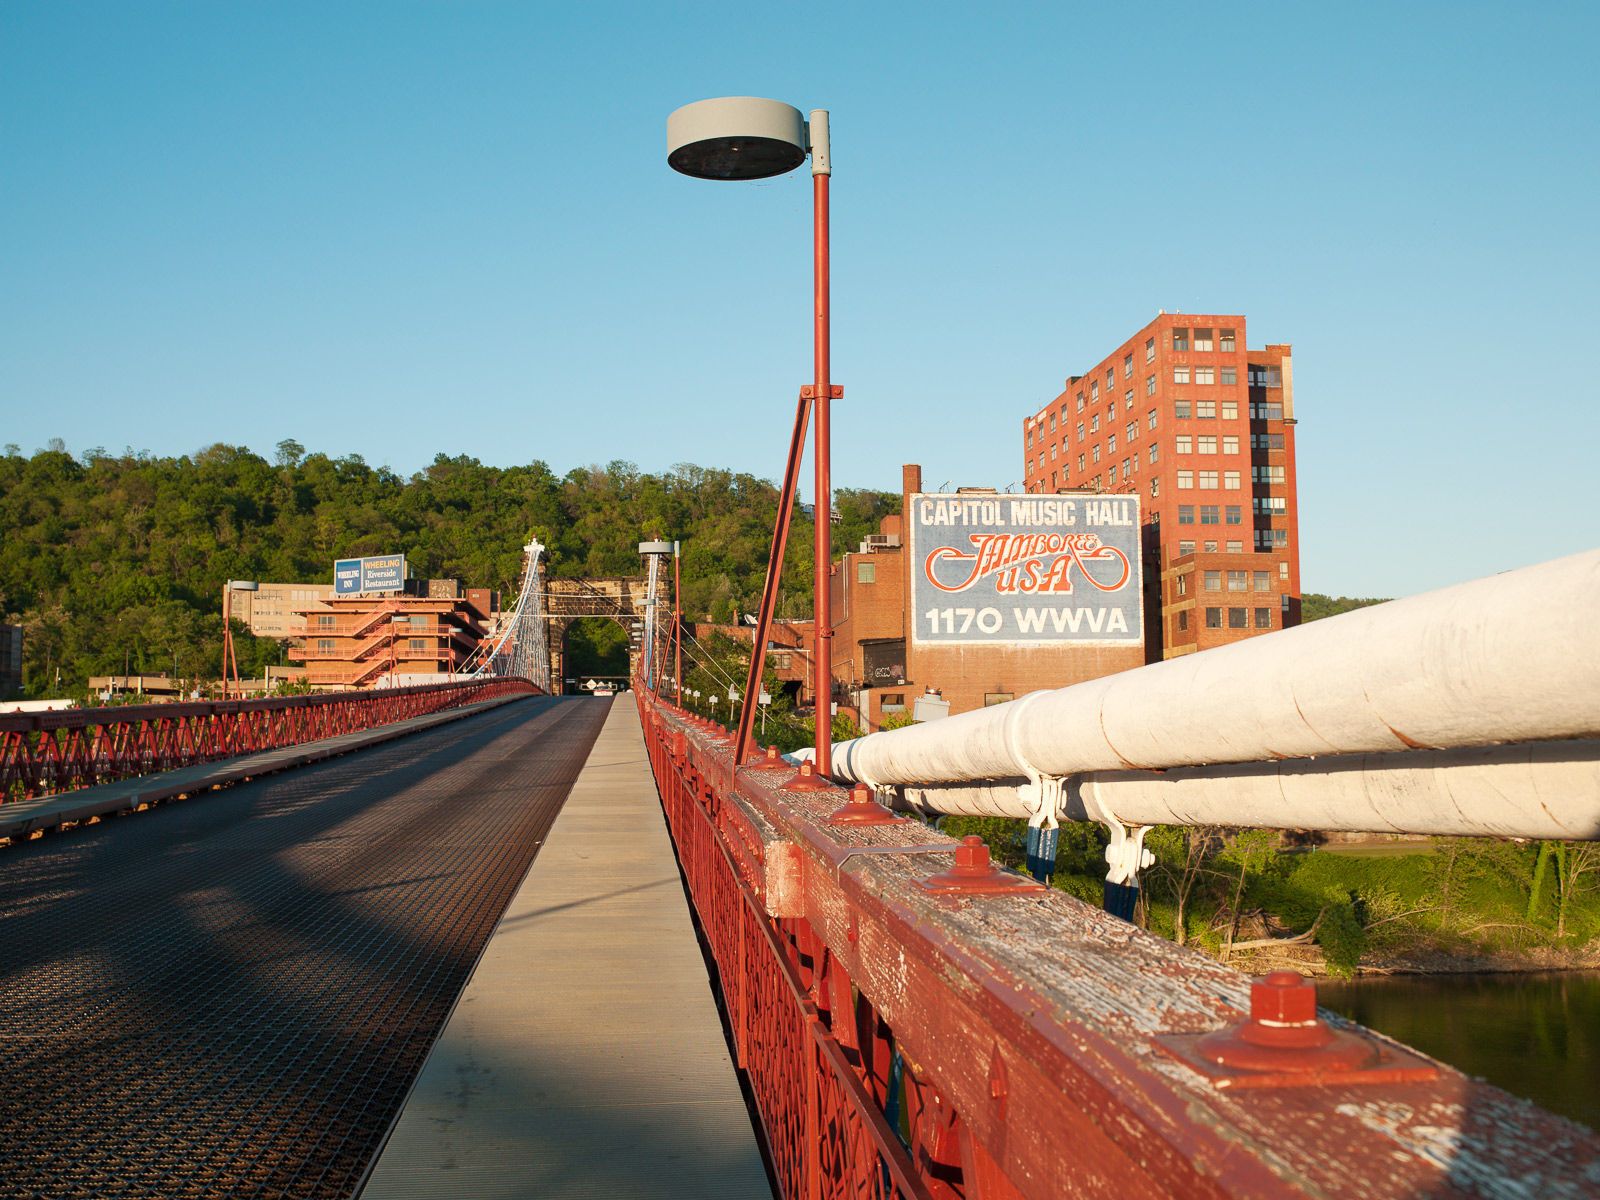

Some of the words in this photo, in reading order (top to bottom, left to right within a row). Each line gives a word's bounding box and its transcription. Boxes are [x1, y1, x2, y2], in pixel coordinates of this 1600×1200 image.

[920, 500, 1005, 526] CAPITOL
[1011, 500, 1075, 526] MUSIC
[1085, 500, 1133, 526] HALL
[364, 559, 400, 569] WHEELING
[367, 569, 397, 578] Riverside
[996, 554, 1073, 595] USA
[365, 578, 400, 588] Restaurant
[925, 607, 1003, 634] 1170
[1013, 607, 1129, 633] WWVA
